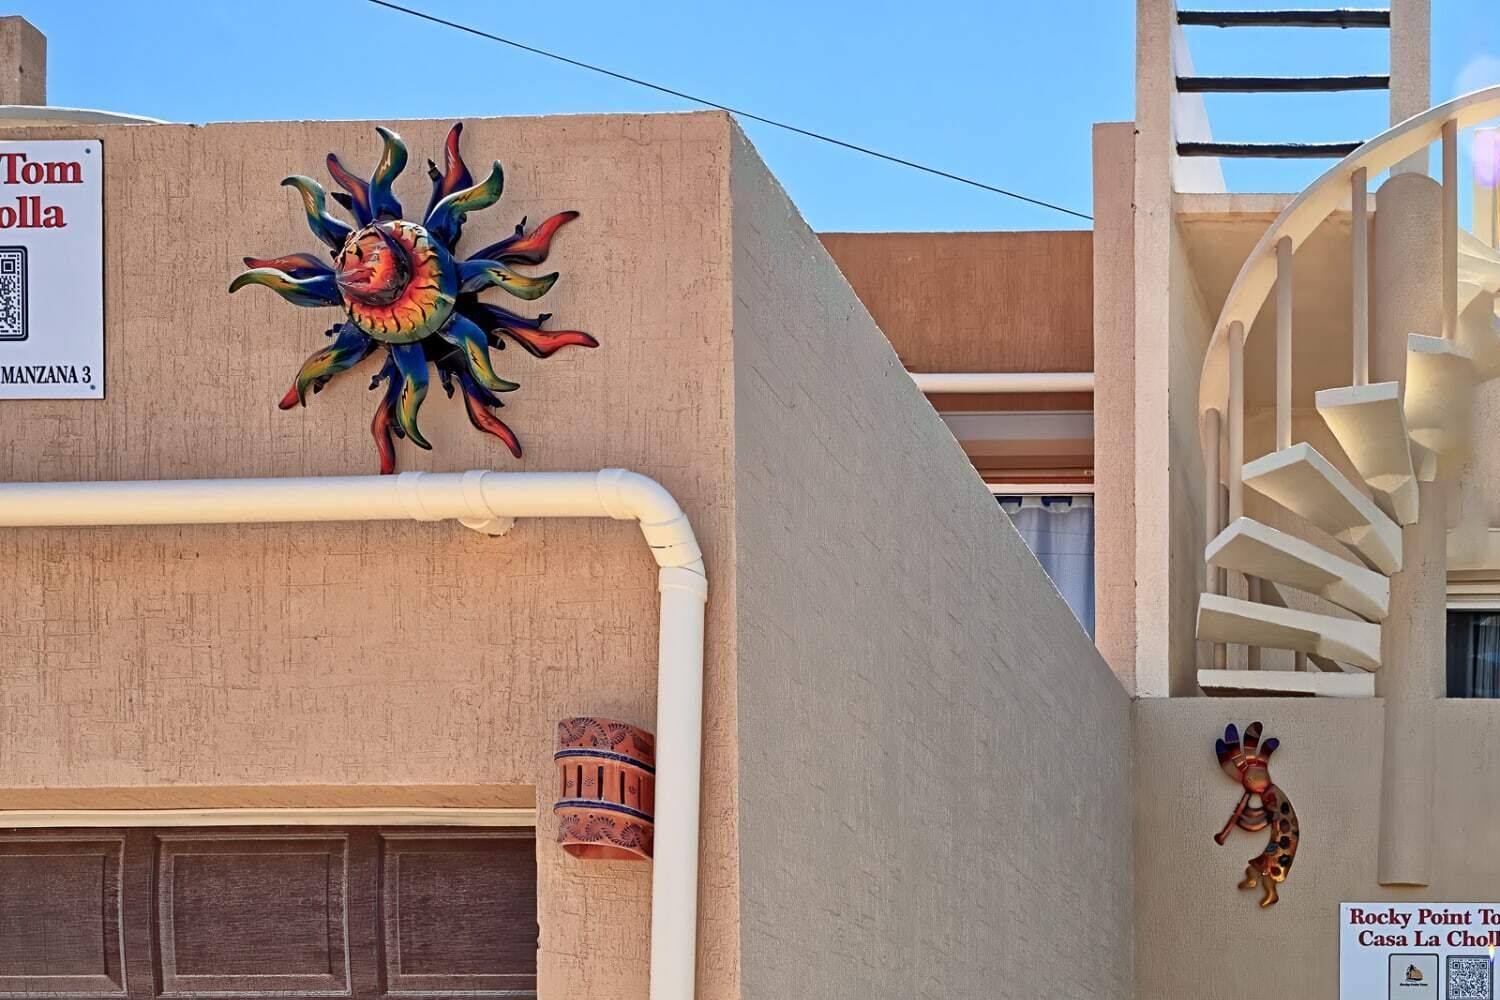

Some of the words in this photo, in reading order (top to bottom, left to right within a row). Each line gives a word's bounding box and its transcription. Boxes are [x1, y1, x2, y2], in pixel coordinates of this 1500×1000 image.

[0, 152, 84, 184] Tom
[0, 365, 79, 385] MANZANA
[82, 365, 92, 384] 3
[1350, 908, 1412, 929] Rocky
[1418, 908, 1472, 926] Point
[1358, 930, 1409, 948] Casa
[1414, 930, 1441, 947] La
